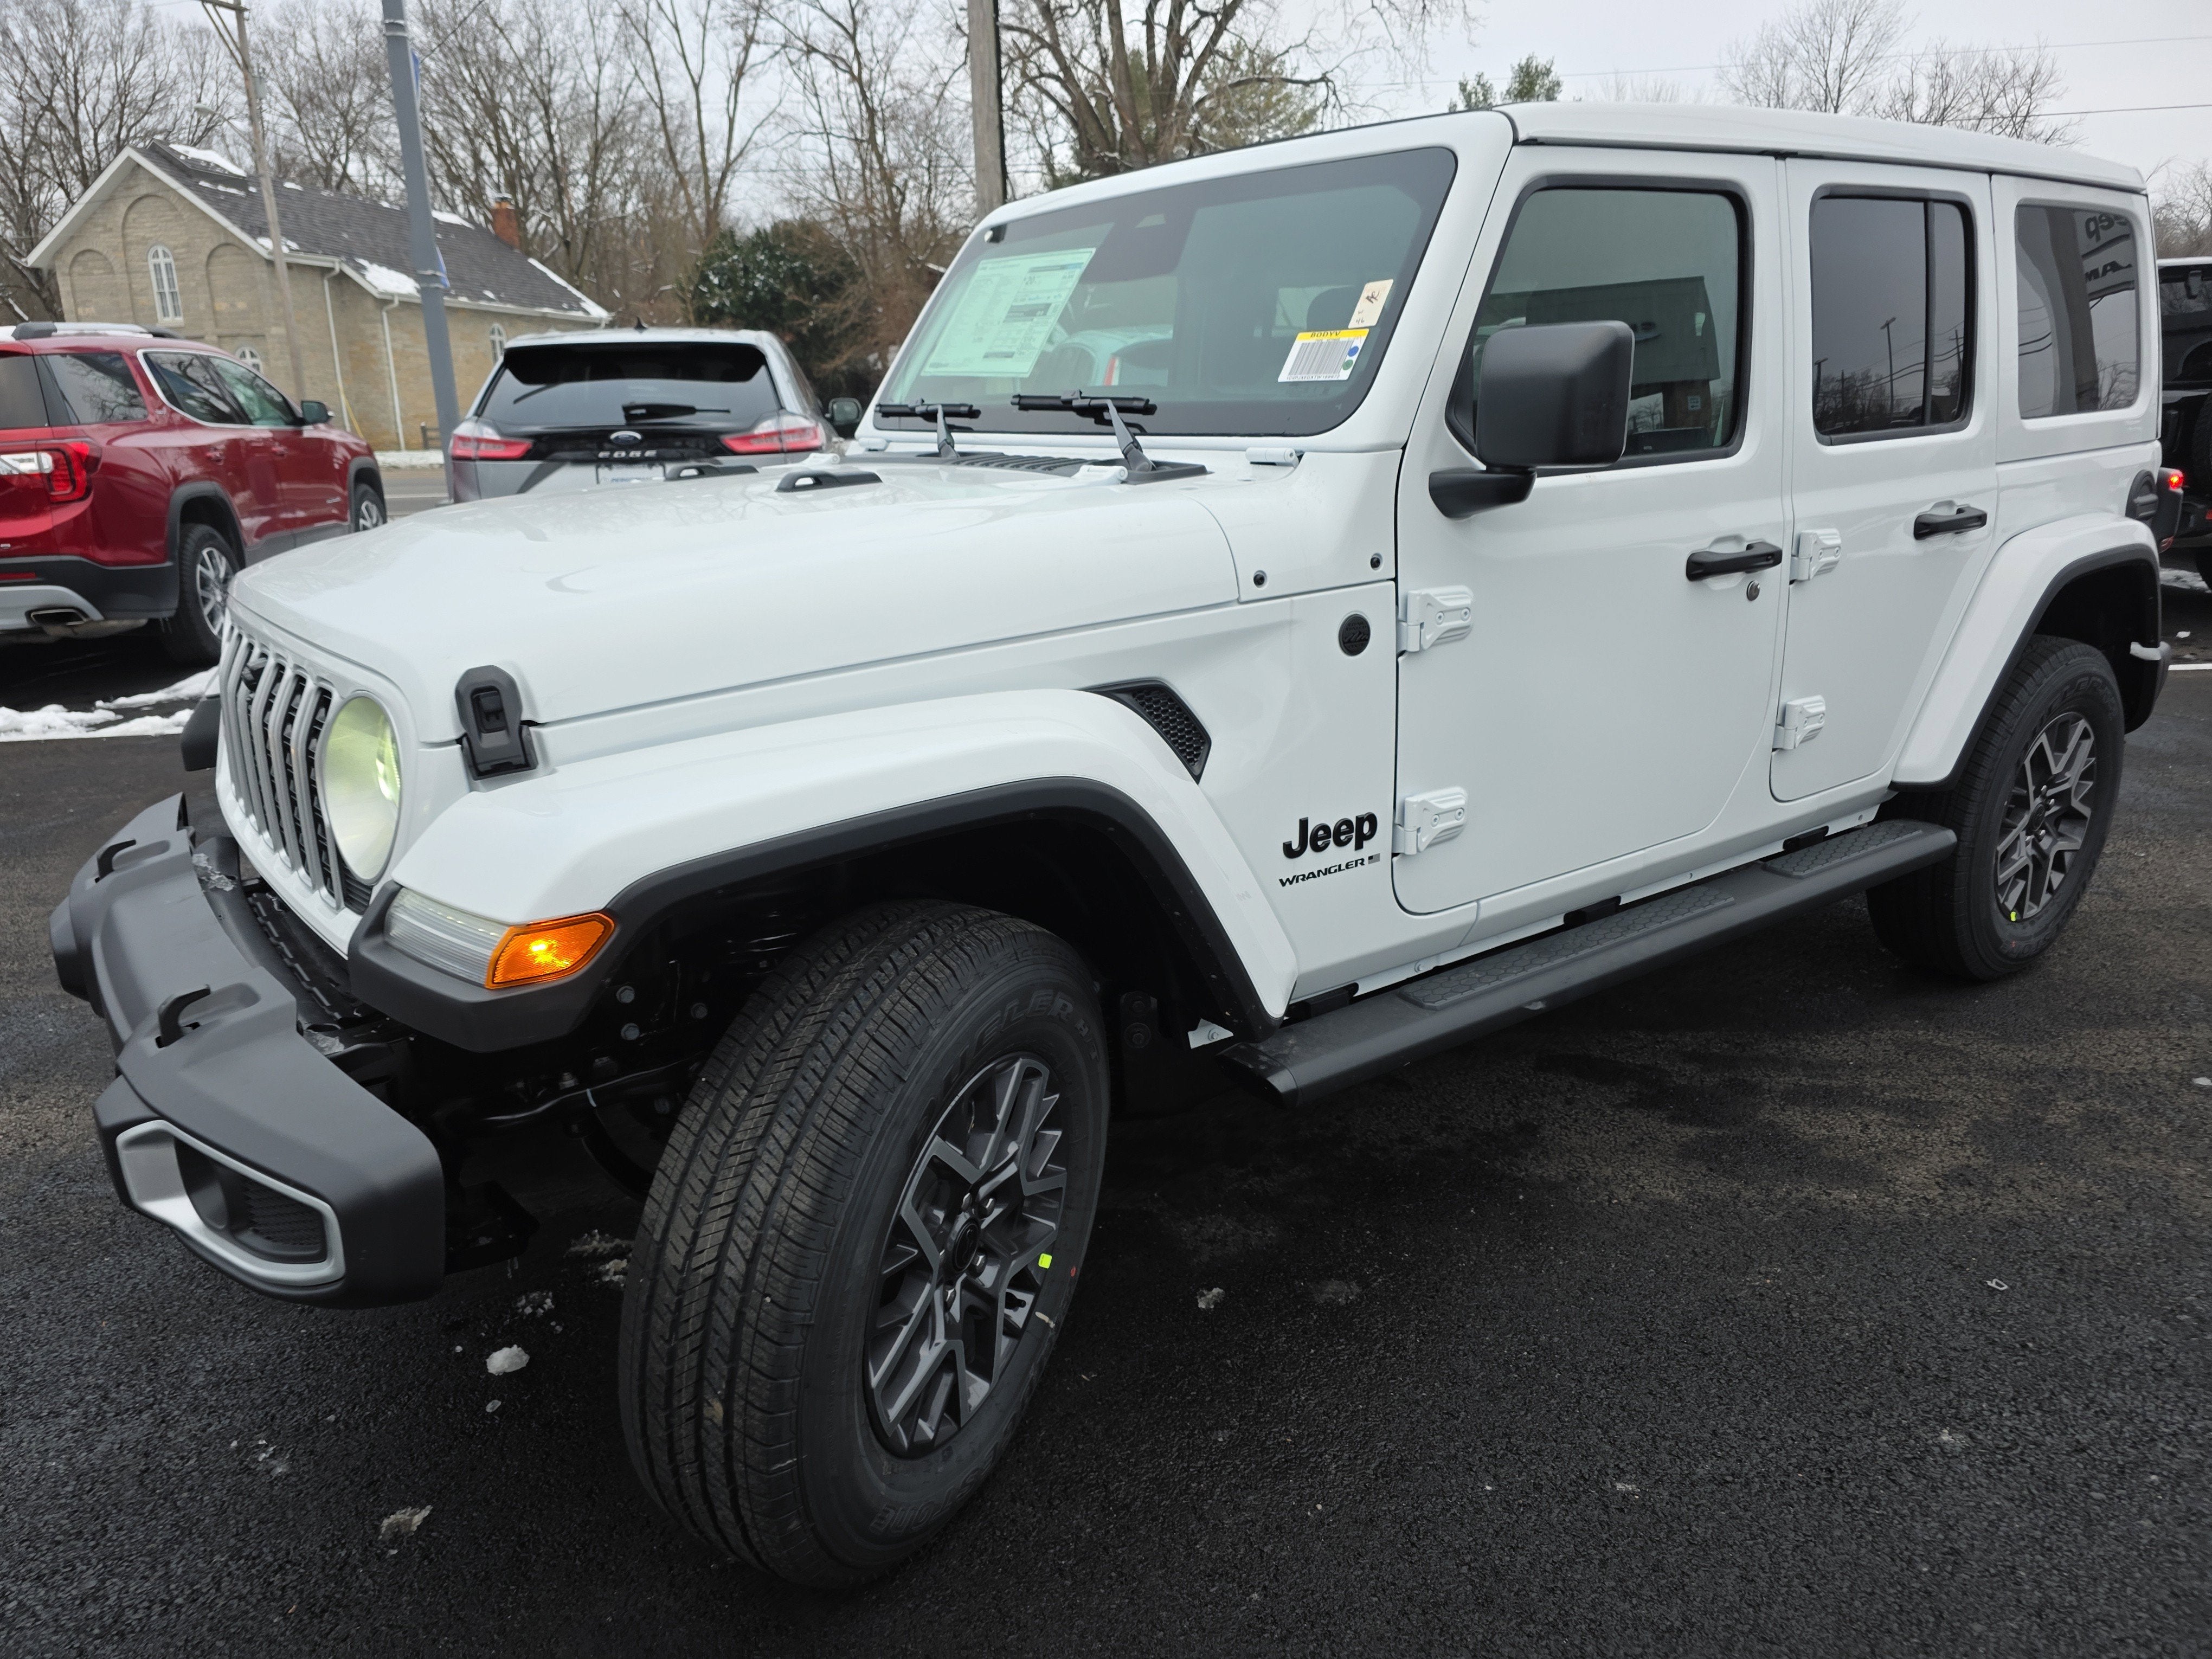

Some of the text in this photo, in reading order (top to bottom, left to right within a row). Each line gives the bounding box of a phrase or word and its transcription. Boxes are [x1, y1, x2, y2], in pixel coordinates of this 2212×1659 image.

[597, 449, 657, 459] EDGE
[1282, 812, 1378, 859] Jeep
[1278, 857, 1366, 888] WRANGLER
